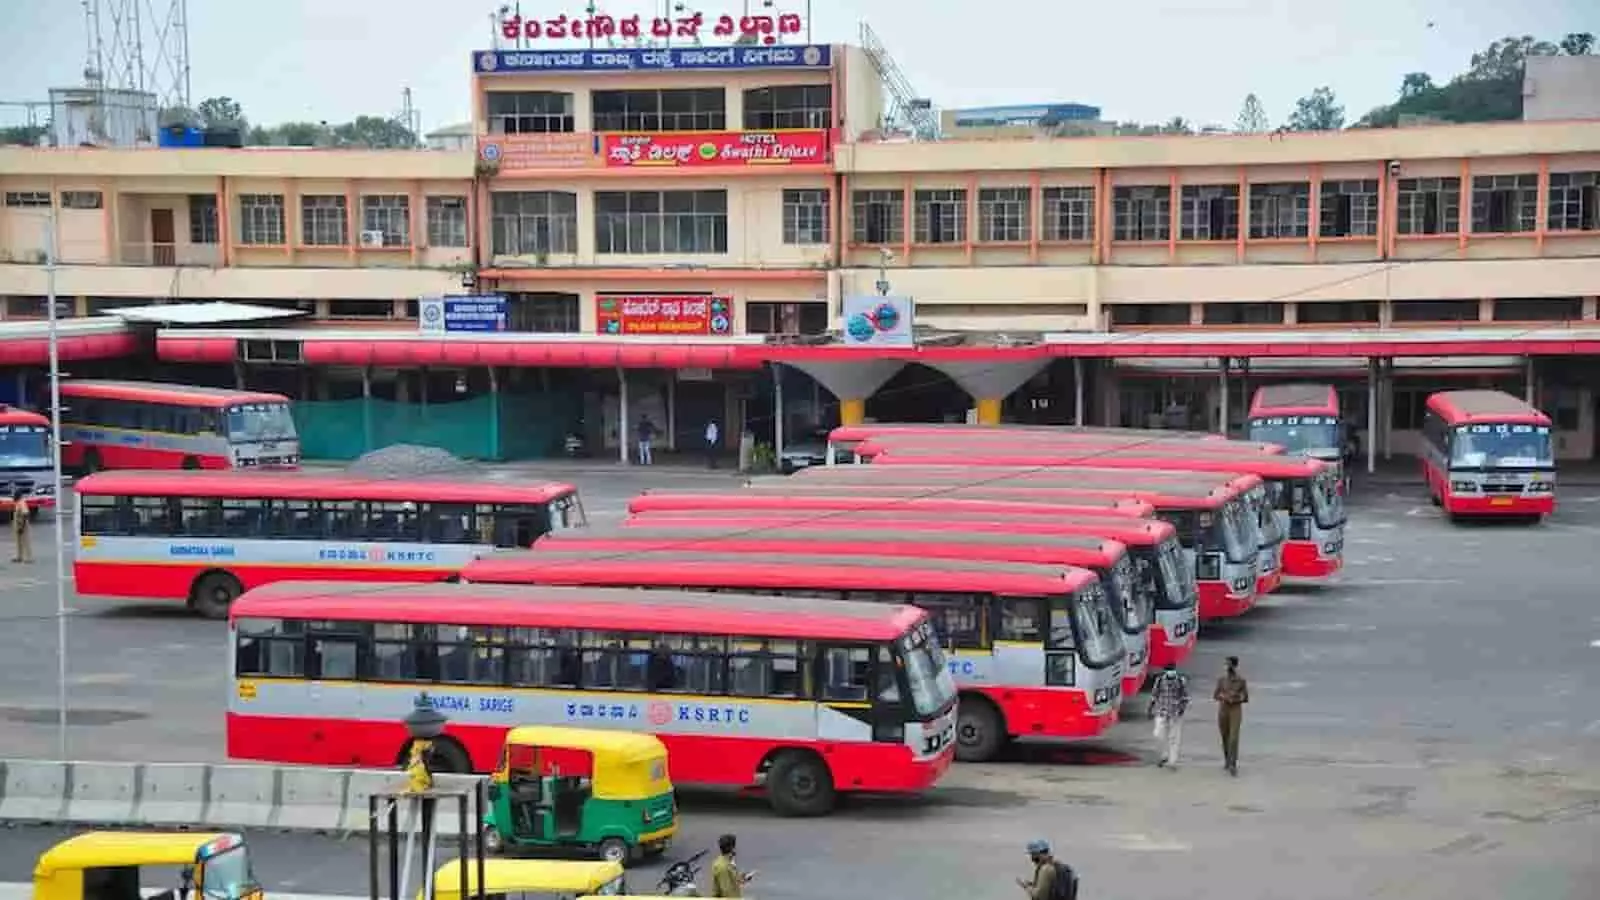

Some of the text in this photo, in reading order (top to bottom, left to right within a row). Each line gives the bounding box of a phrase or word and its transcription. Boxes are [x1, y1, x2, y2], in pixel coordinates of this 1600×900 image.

[501, 12, 801, 46] ಕೆಂಪೇಗೌಡ ಬಸ್ ನಿಲ್ದಾಣ
[740, 133, 776, 144] HOTEL
[720, 143, 818, 160] Swathi Deluxe
[678, 705, 750, 723] KSRTC
